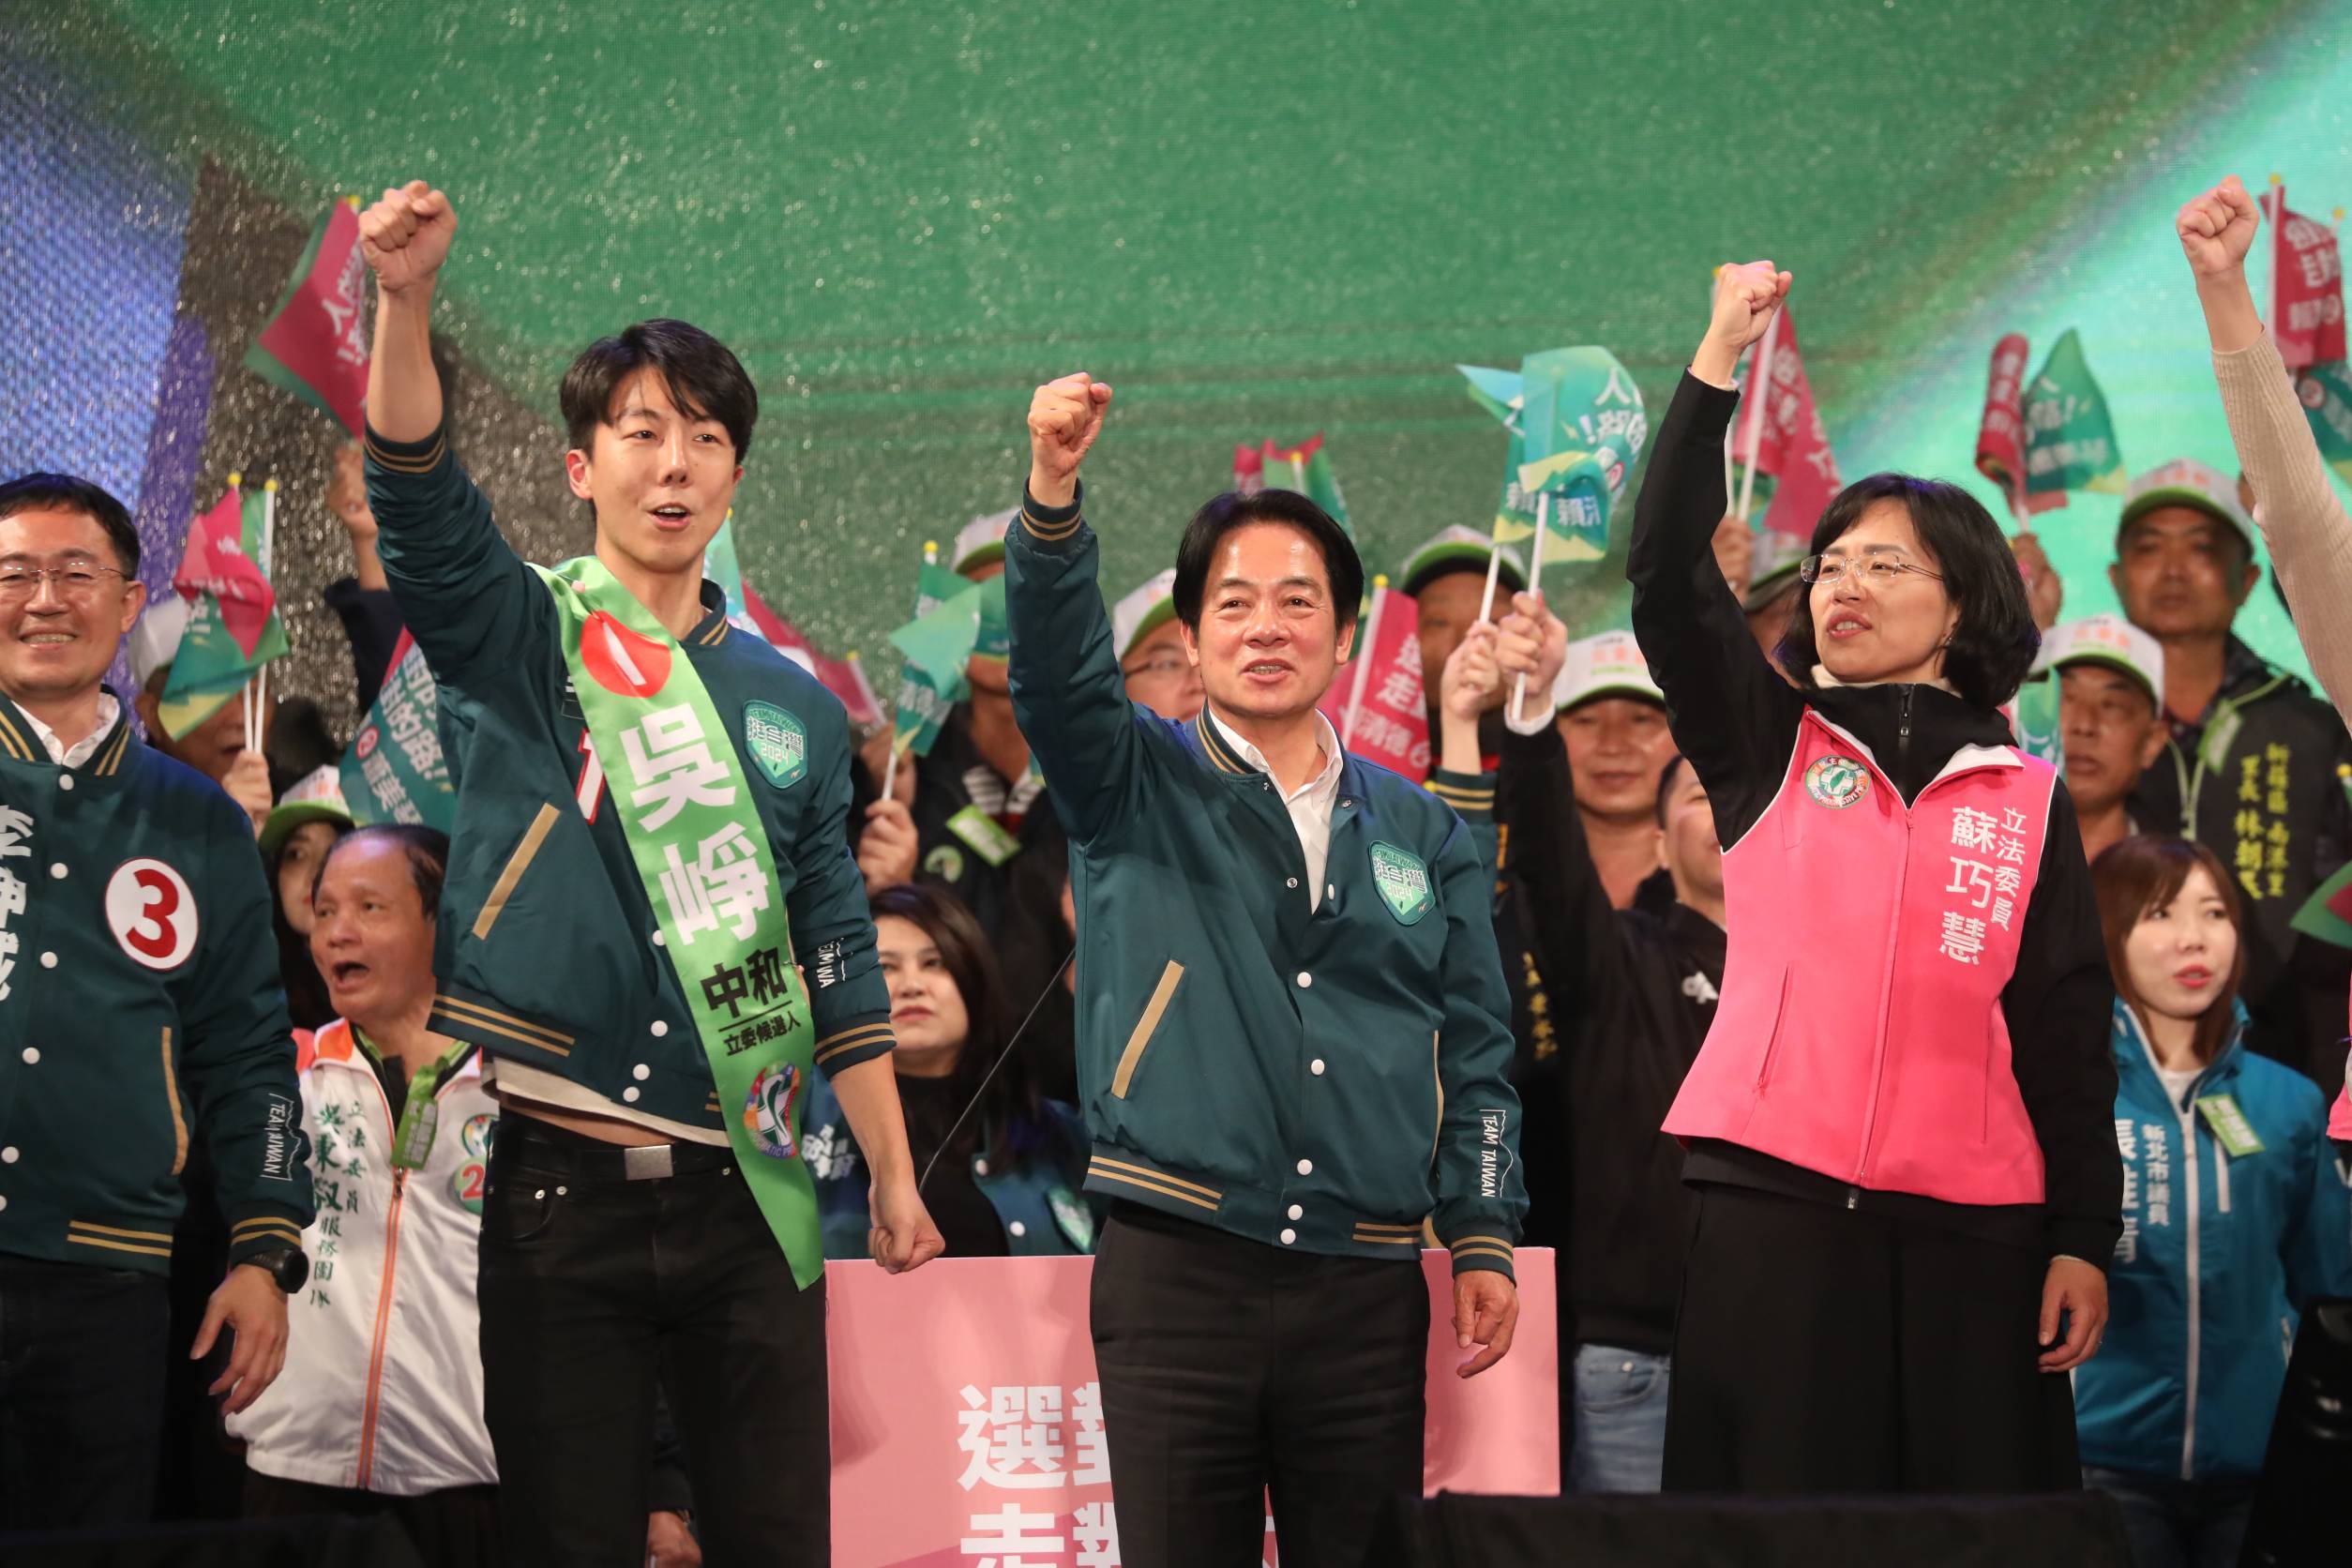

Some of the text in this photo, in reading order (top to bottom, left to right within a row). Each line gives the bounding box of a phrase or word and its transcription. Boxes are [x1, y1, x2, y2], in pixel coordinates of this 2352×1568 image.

[619, 703, 769, 945] 吳崢
[1990, 807, 2027, 931] 立法委員
[126, 868, 179, 958] 3
[1939, 807, 1998, 965] 蘇巧慧
[701, 946, 788, 1018] 中和
[724, 1010, 801, 1056] 立委候選人
[342, 1100, 367, 1214] 立法委員
[1482, 1115, 1499, 1198] TEAM TAIWAN
[960, 1502, 1122, 1568] 走
